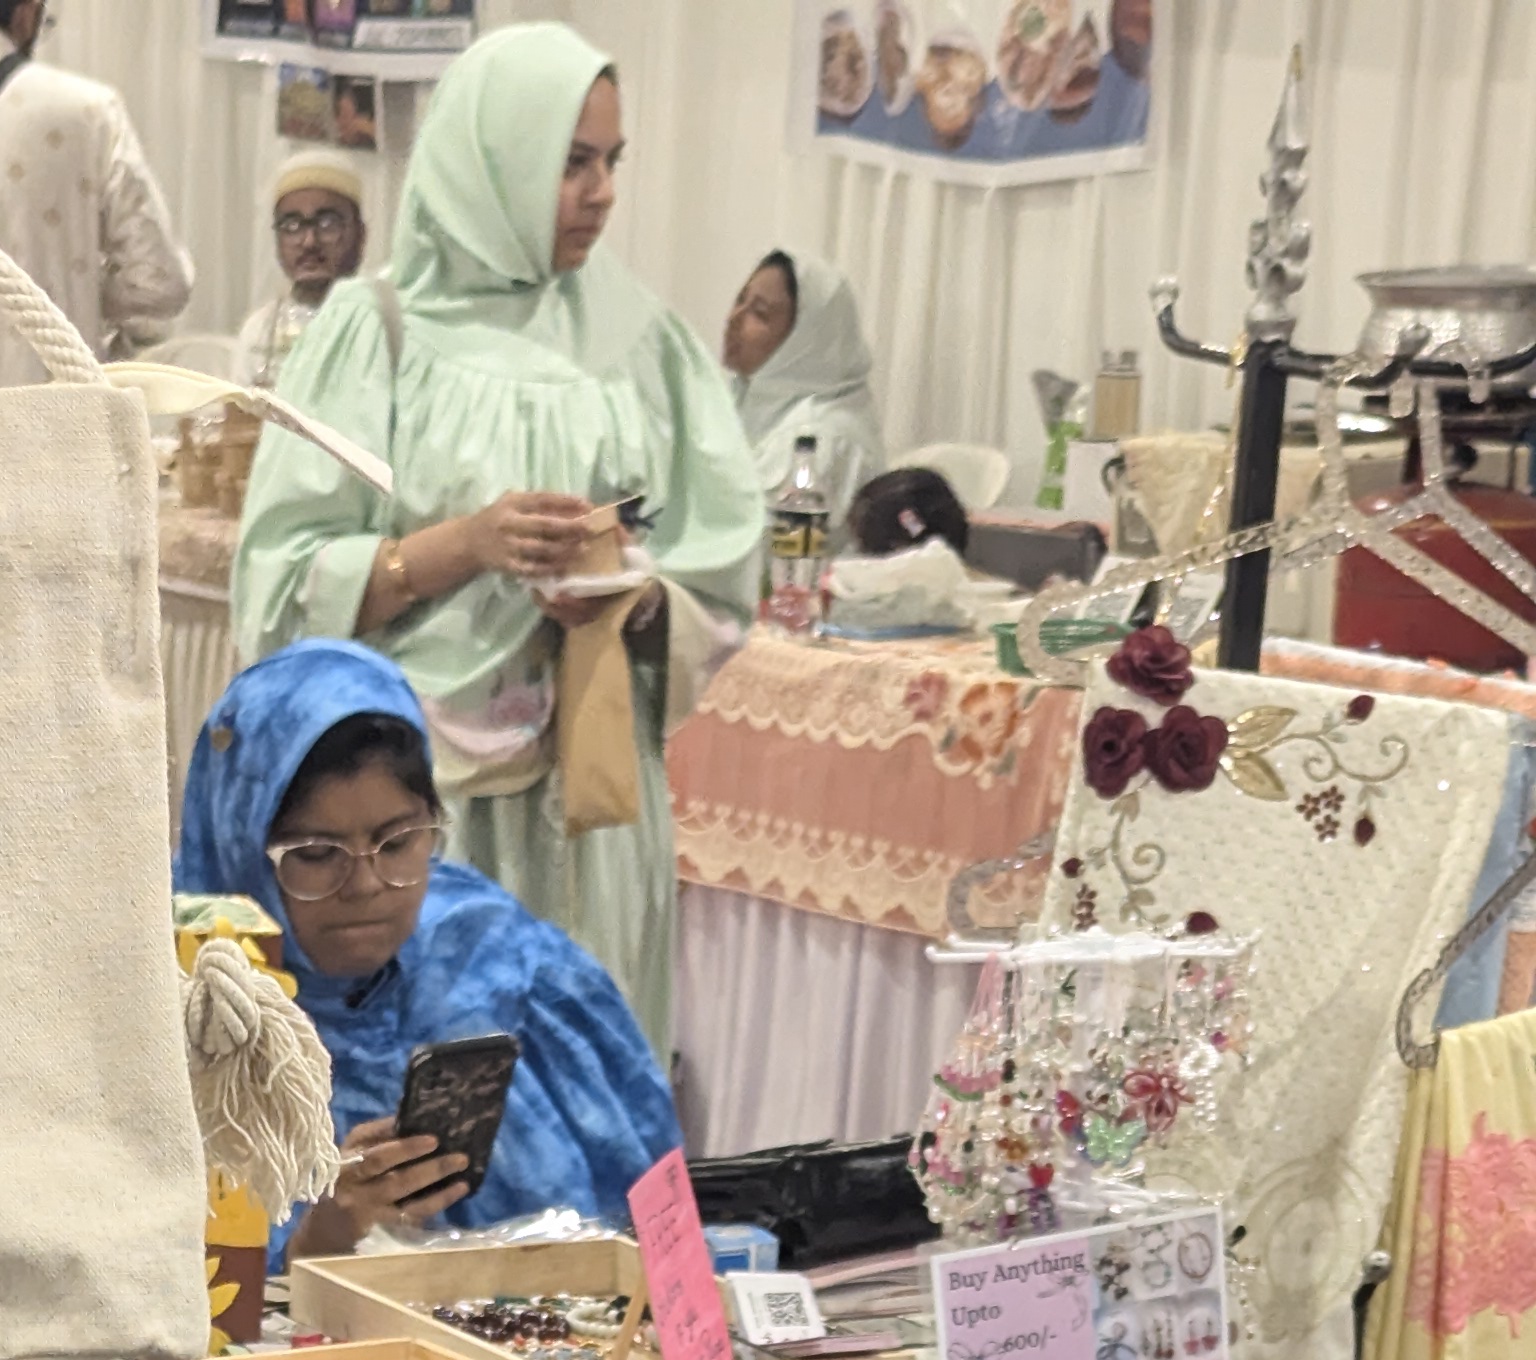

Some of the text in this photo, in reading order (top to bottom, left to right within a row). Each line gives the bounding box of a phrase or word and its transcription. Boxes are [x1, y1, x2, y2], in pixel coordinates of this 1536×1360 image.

[949, 1252, 1086, 1291] Buy Anything
[951, 1305, 1002, 1329] Upto
[1003, 1325, 1057, 1350] 600/-
